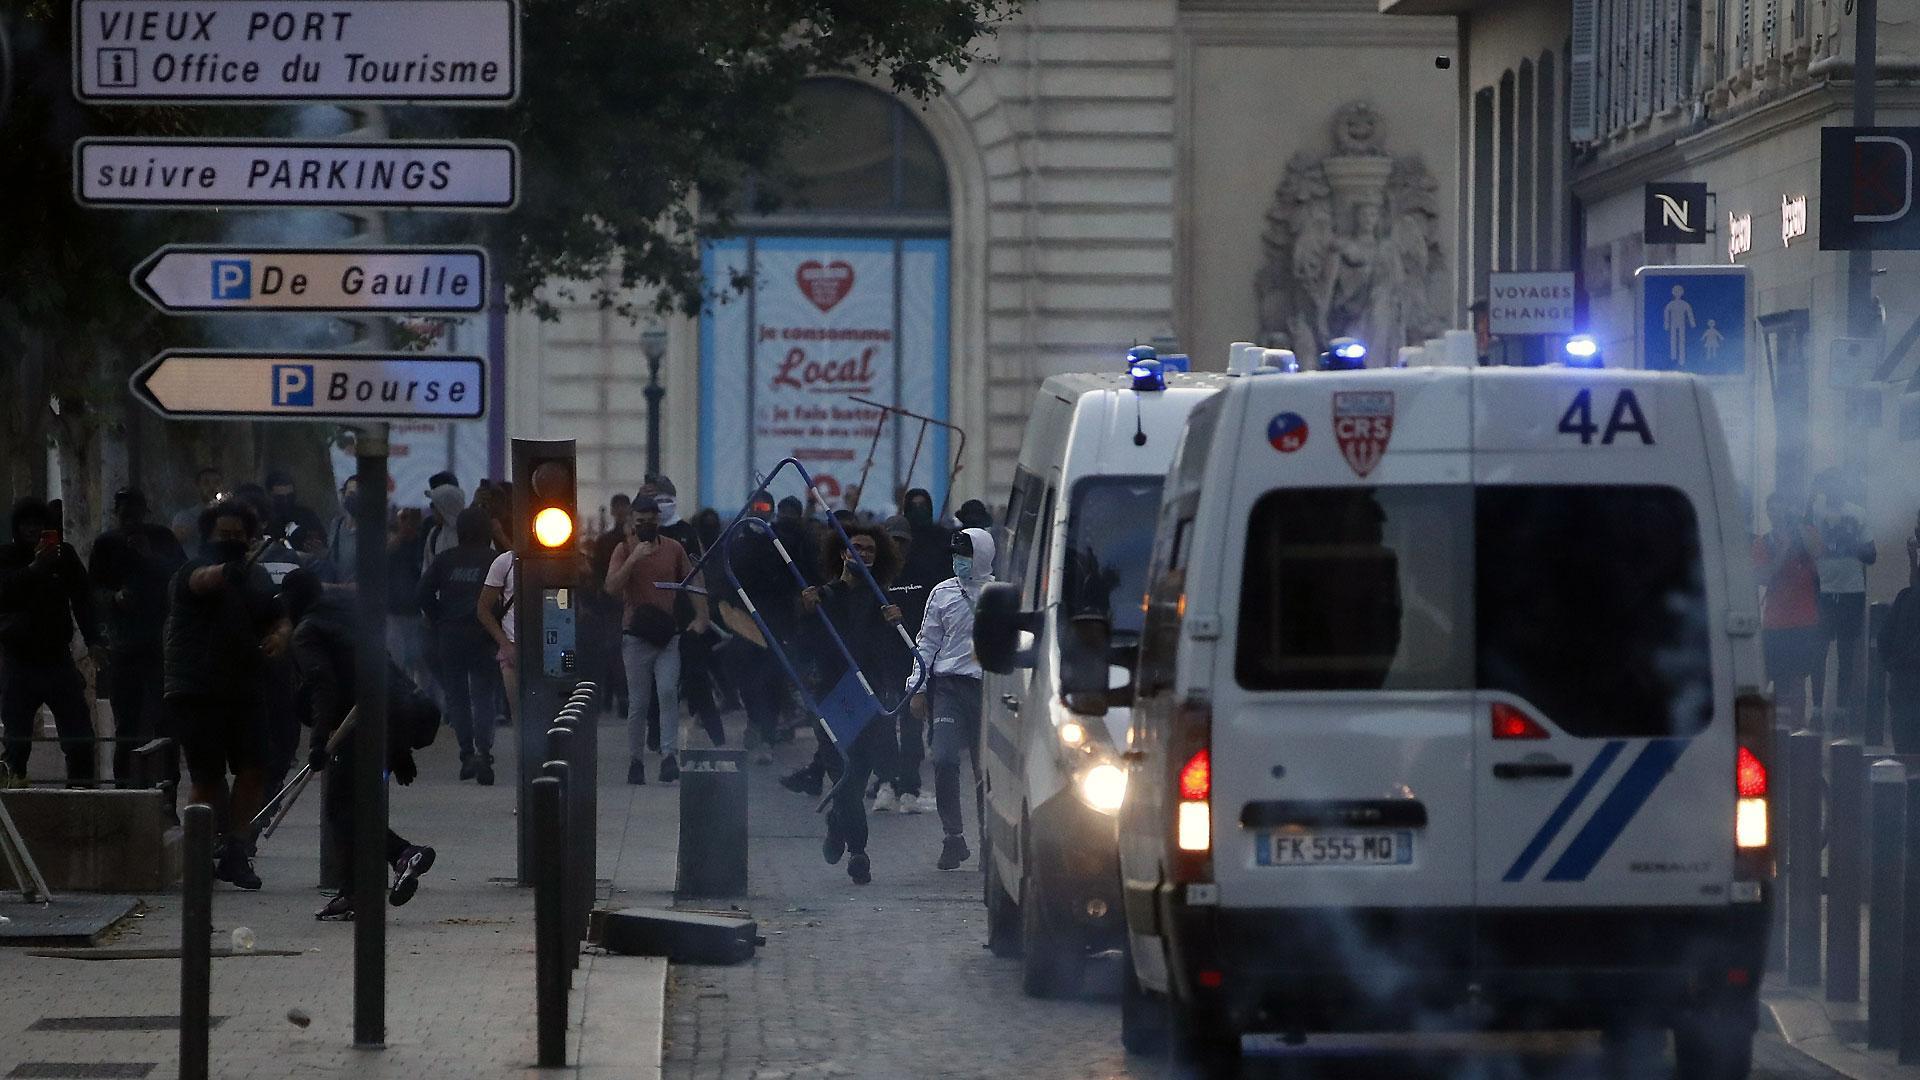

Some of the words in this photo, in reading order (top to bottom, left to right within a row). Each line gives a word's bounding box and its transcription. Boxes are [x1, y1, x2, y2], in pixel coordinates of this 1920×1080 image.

[100, 11, 217, 41] VIEUX
[247, 11, 352, 41] PORT
[152, 53, 259, 83] Office
[281, 53, 320, 83] du
[344, 53, 498, 83] Tourisme
[97, 159, 218, 188] suivre
[247, 160, 452, 190] PARKINGS
[1655, 193, 1697, 233] N
[218, 264, 244, 297] P
[260, 266, 308, 295] De
[341, 266, 469, 296] Gaulle
[1494, 286, 1571, 299] VOYAGES
[1491, 306, 1572, 320] CHANGE
[769, 347, 877, 389] Local
[278, 367, 306, 404] P
[327, 372, 466, 402] Bourse
[1338, 418, 1388, 439] CRS
[1558, 387, 1656, 445] 4A
